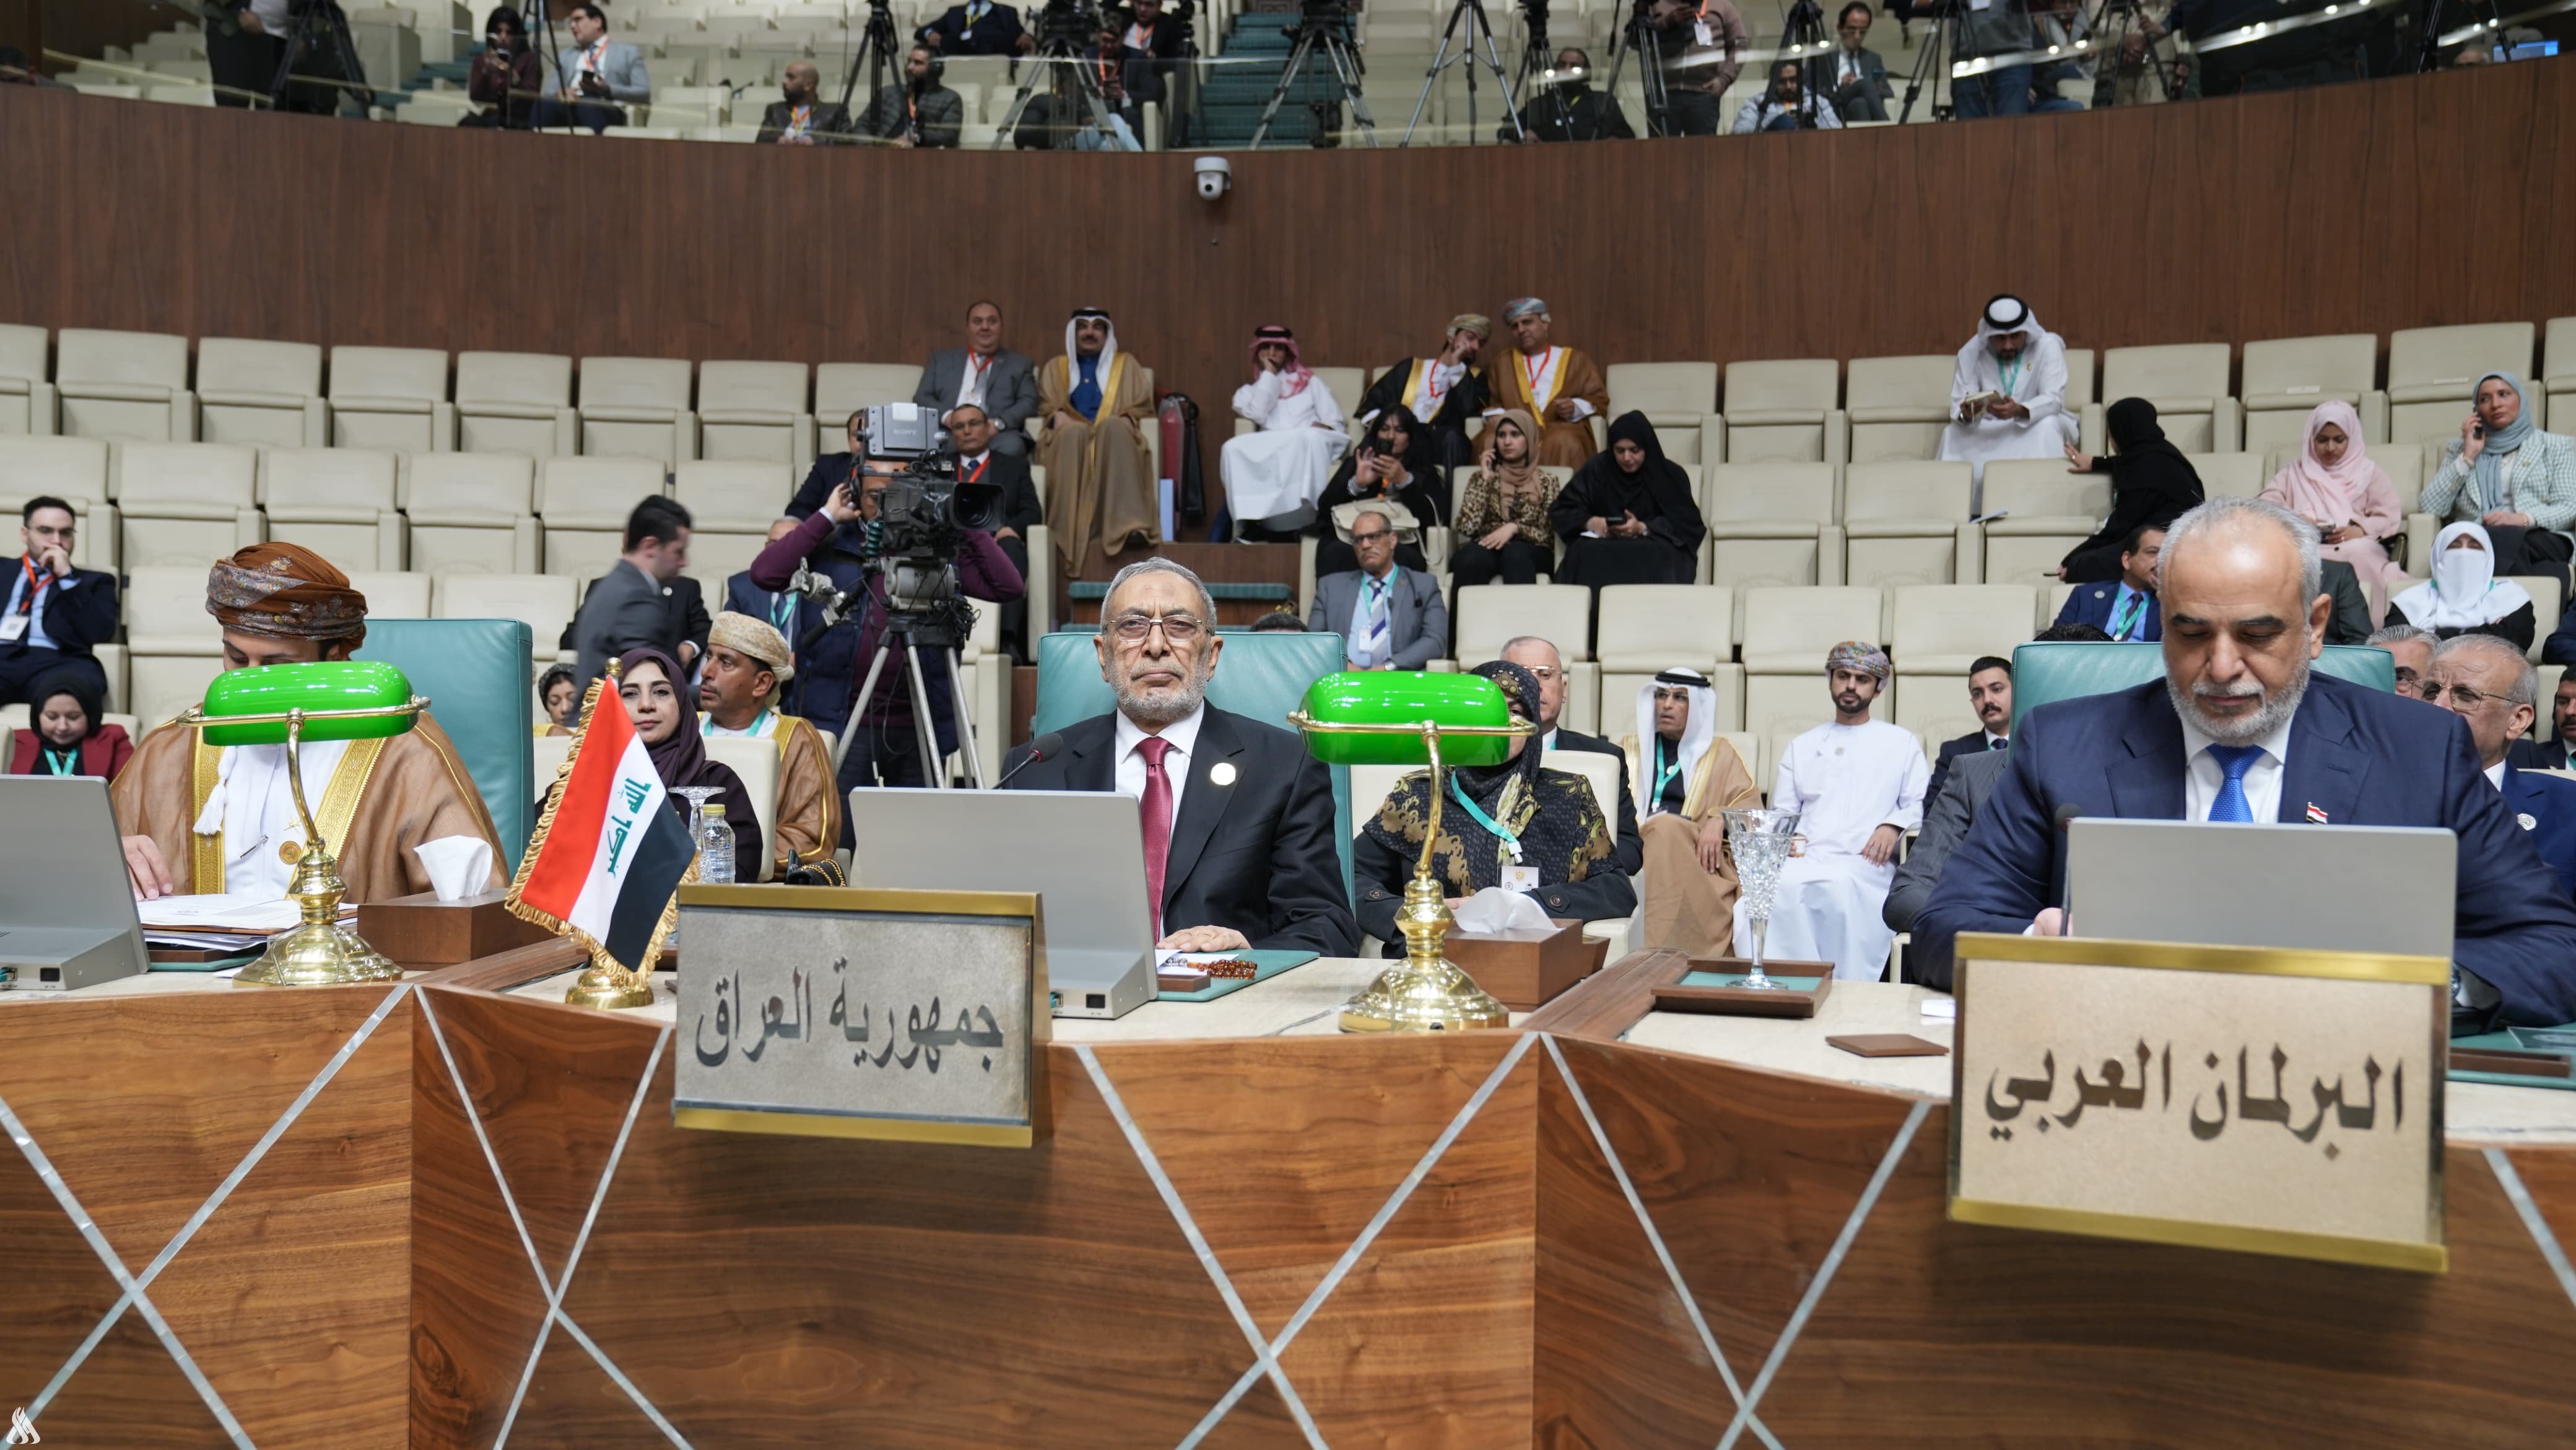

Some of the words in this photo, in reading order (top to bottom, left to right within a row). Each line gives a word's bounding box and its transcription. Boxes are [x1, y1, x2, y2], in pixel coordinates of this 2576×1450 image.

[695, 965, 812, 1067] العراق
[829, 956, 1004, 1074] جمهورية
[1984, 1037, 2172, 1142] العربي
[2189, 1042, 2403, 1161] البرلمان
